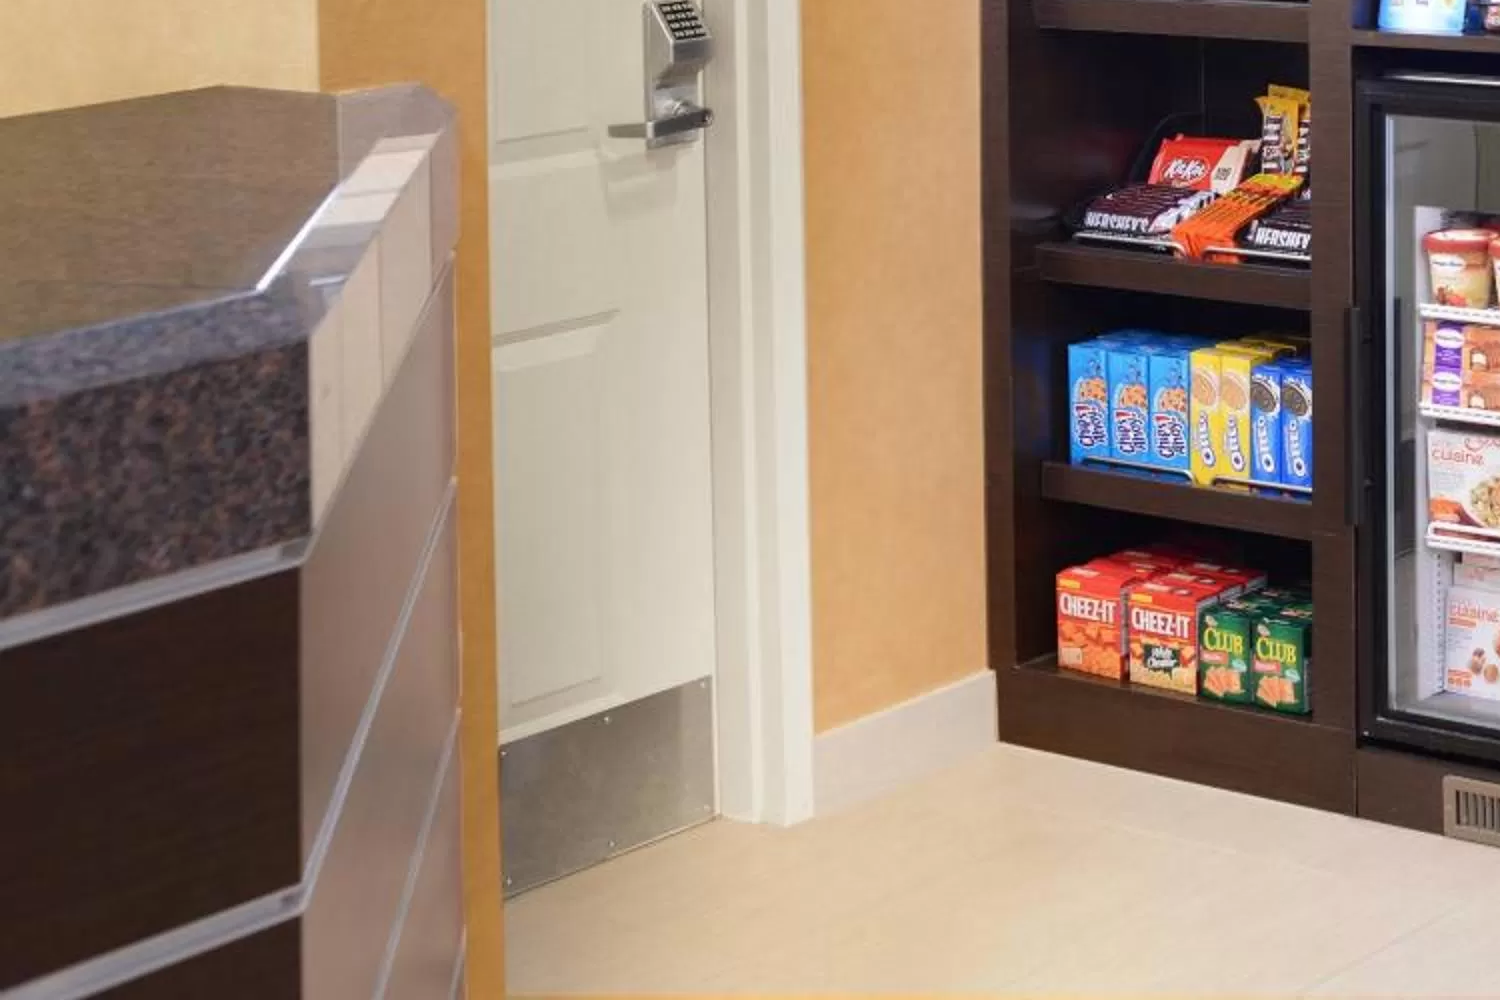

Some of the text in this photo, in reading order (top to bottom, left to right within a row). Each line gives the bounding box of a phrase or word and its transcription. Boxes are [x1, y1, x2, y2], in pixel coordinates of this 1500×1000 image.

[1058, 592, 1117, 625] CHEEZ-IT
[1131, 606, 1191, 639] CHEEZ-IT
[1203, 627, 1243, 656] CLUB
[1256, 636, 1298, 665] CLUB
